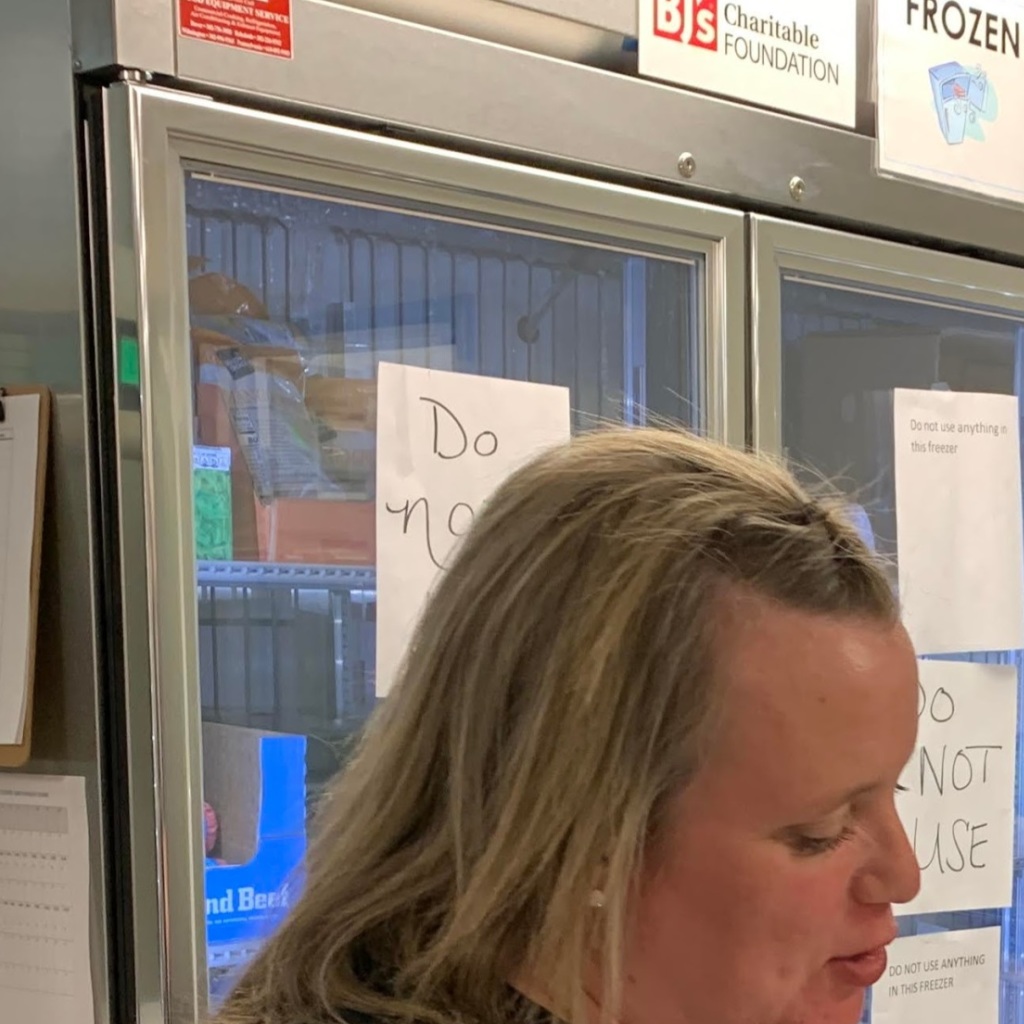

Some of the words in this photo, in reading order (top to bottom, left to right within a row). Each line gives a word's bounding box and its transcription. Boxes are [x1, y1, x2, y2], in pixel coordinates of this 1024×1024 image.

[724, 3, 819, 49] Charitable
[907, 0, 1019, 58] FROZEN
[725, 33, 839, 86] FOUNDATION
[419, 396, 498, 460] Do
[910, 418, 922, 431] Do
[924, 421, 938, 431] not
[940, 422, 955, 433] use
[957, 421, 999, 437] anything
[1001, 424, 1008, 434] in
[911, 440, 926, 453] this
[928, 440, 958, 454] freezer
[920, 745, 1003, 796] NOT
[913, 817, 989, 874] USE
[889, 965, 902, 977] DO
[904, 962, 921, 975] NOT
[923, 959, 939, 972] USE
[941, 954, 985, 969] ANYTHING
[889, 986, 898, 997] IN
[900, 982, 918, 995] THIS
[920, 977, 953, 992] FREEZER
